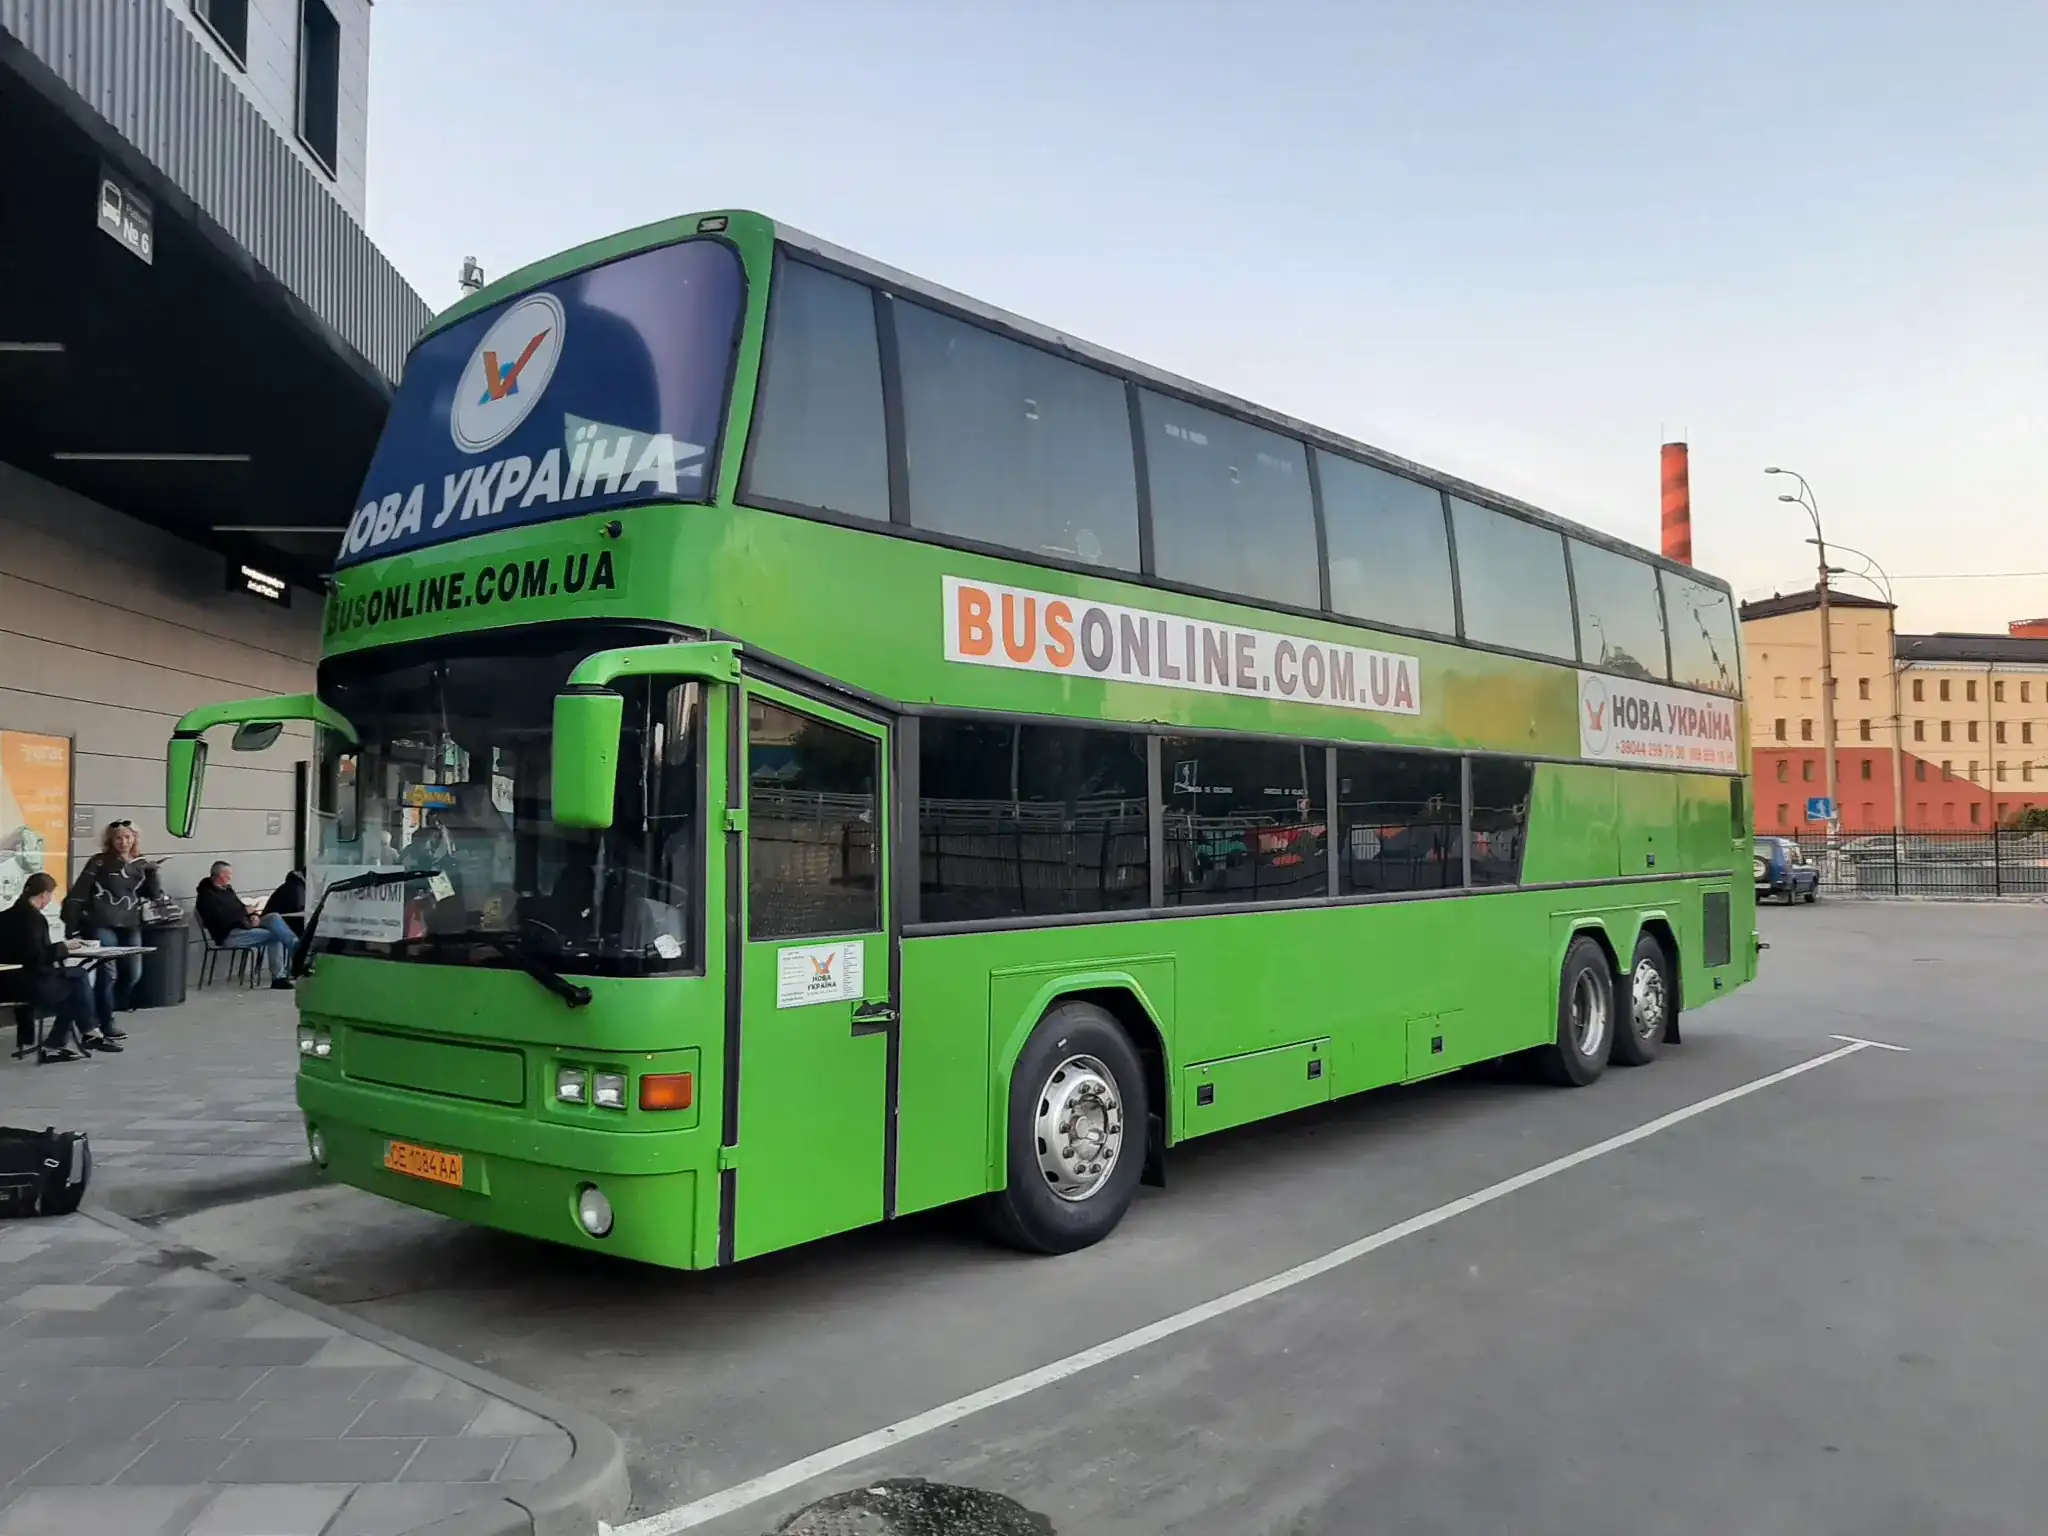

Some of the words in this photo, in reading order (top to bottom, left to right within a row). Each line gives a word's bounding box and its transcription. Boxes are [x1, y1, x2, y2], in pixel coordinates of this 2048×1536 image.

[141, 232, 150, 254] 6
[432, 423, 678, 530] УКРАЇНА
[956, 585, 1415, 709] BUSONLINE.COM.UA
[1612, 694, 1664, 733] НОВА
[1667, 701, 1734, 742] УКРАЇНА
